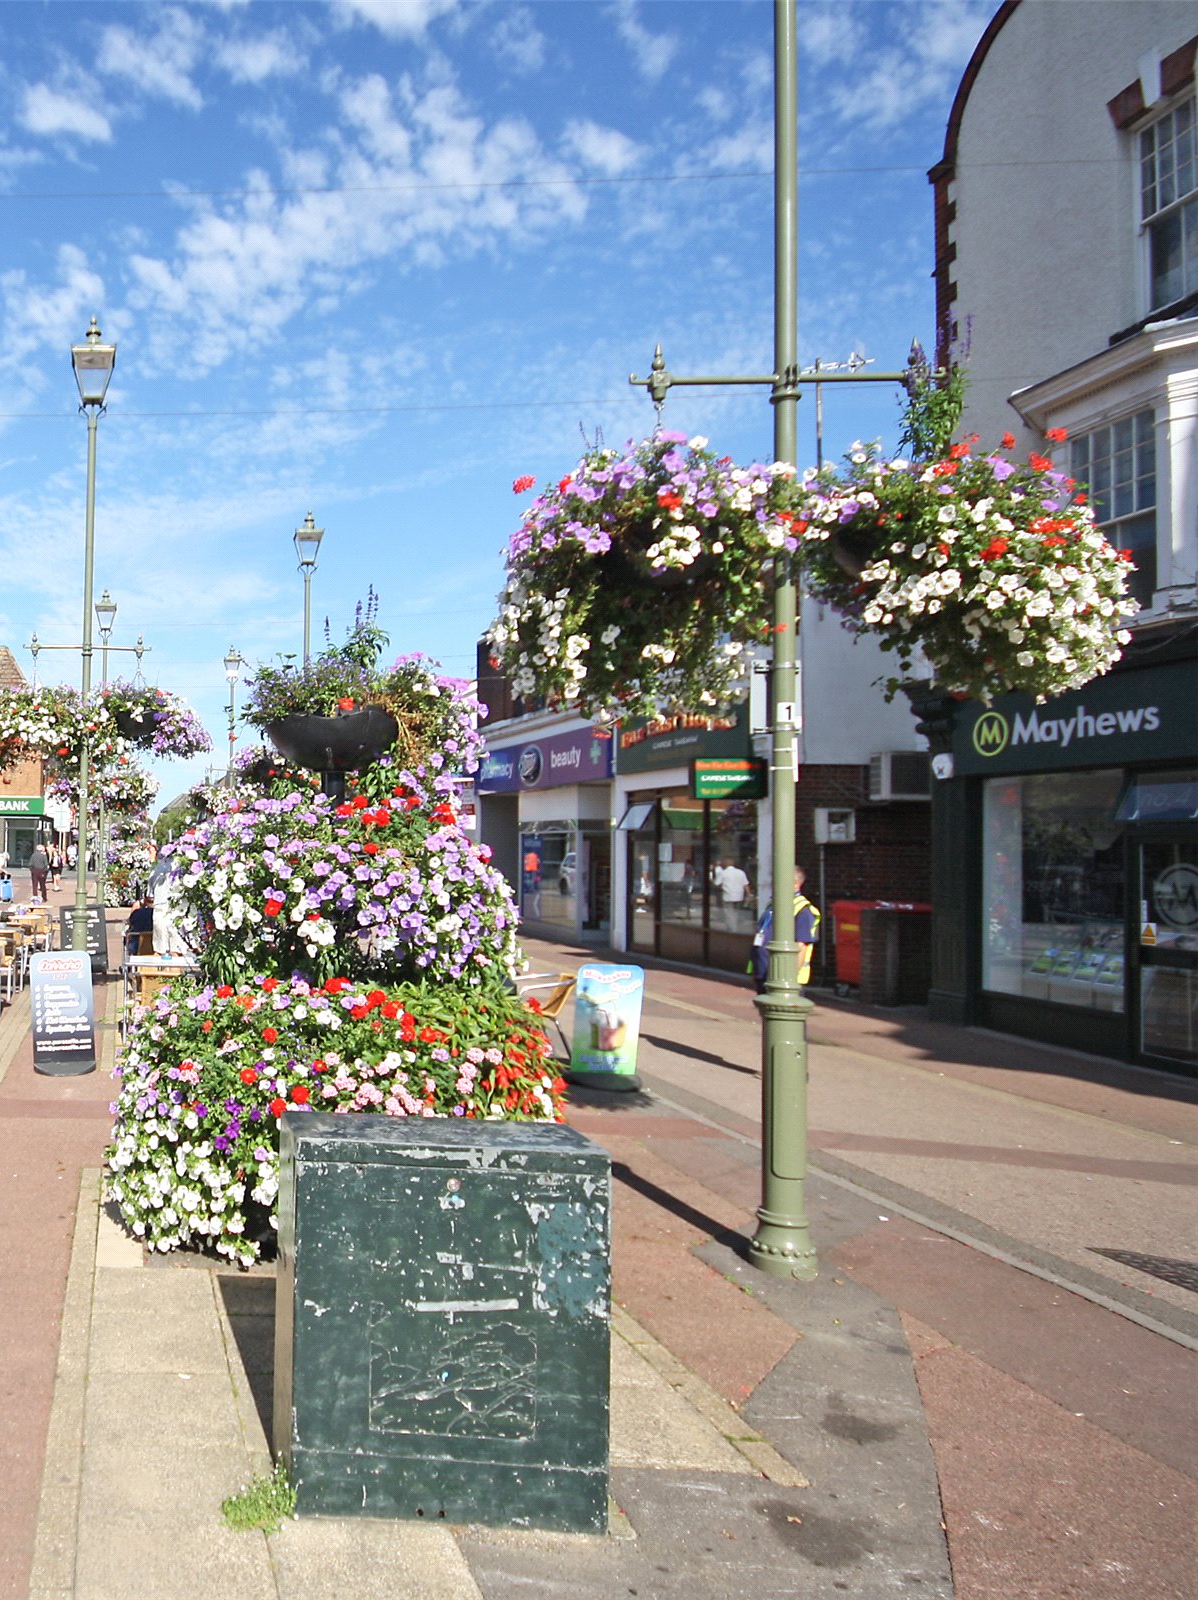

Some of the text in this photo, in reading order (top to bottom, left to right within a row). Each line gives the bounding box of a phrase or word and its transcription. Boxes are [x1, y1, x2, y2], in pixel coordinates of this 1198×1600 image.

[785, 705, 792, 720] 1
[1011, 705, 1160, 747] Mayhews
[550, 746, 581, 769] beauty
[480, 762, 514, 783] pharmacy
